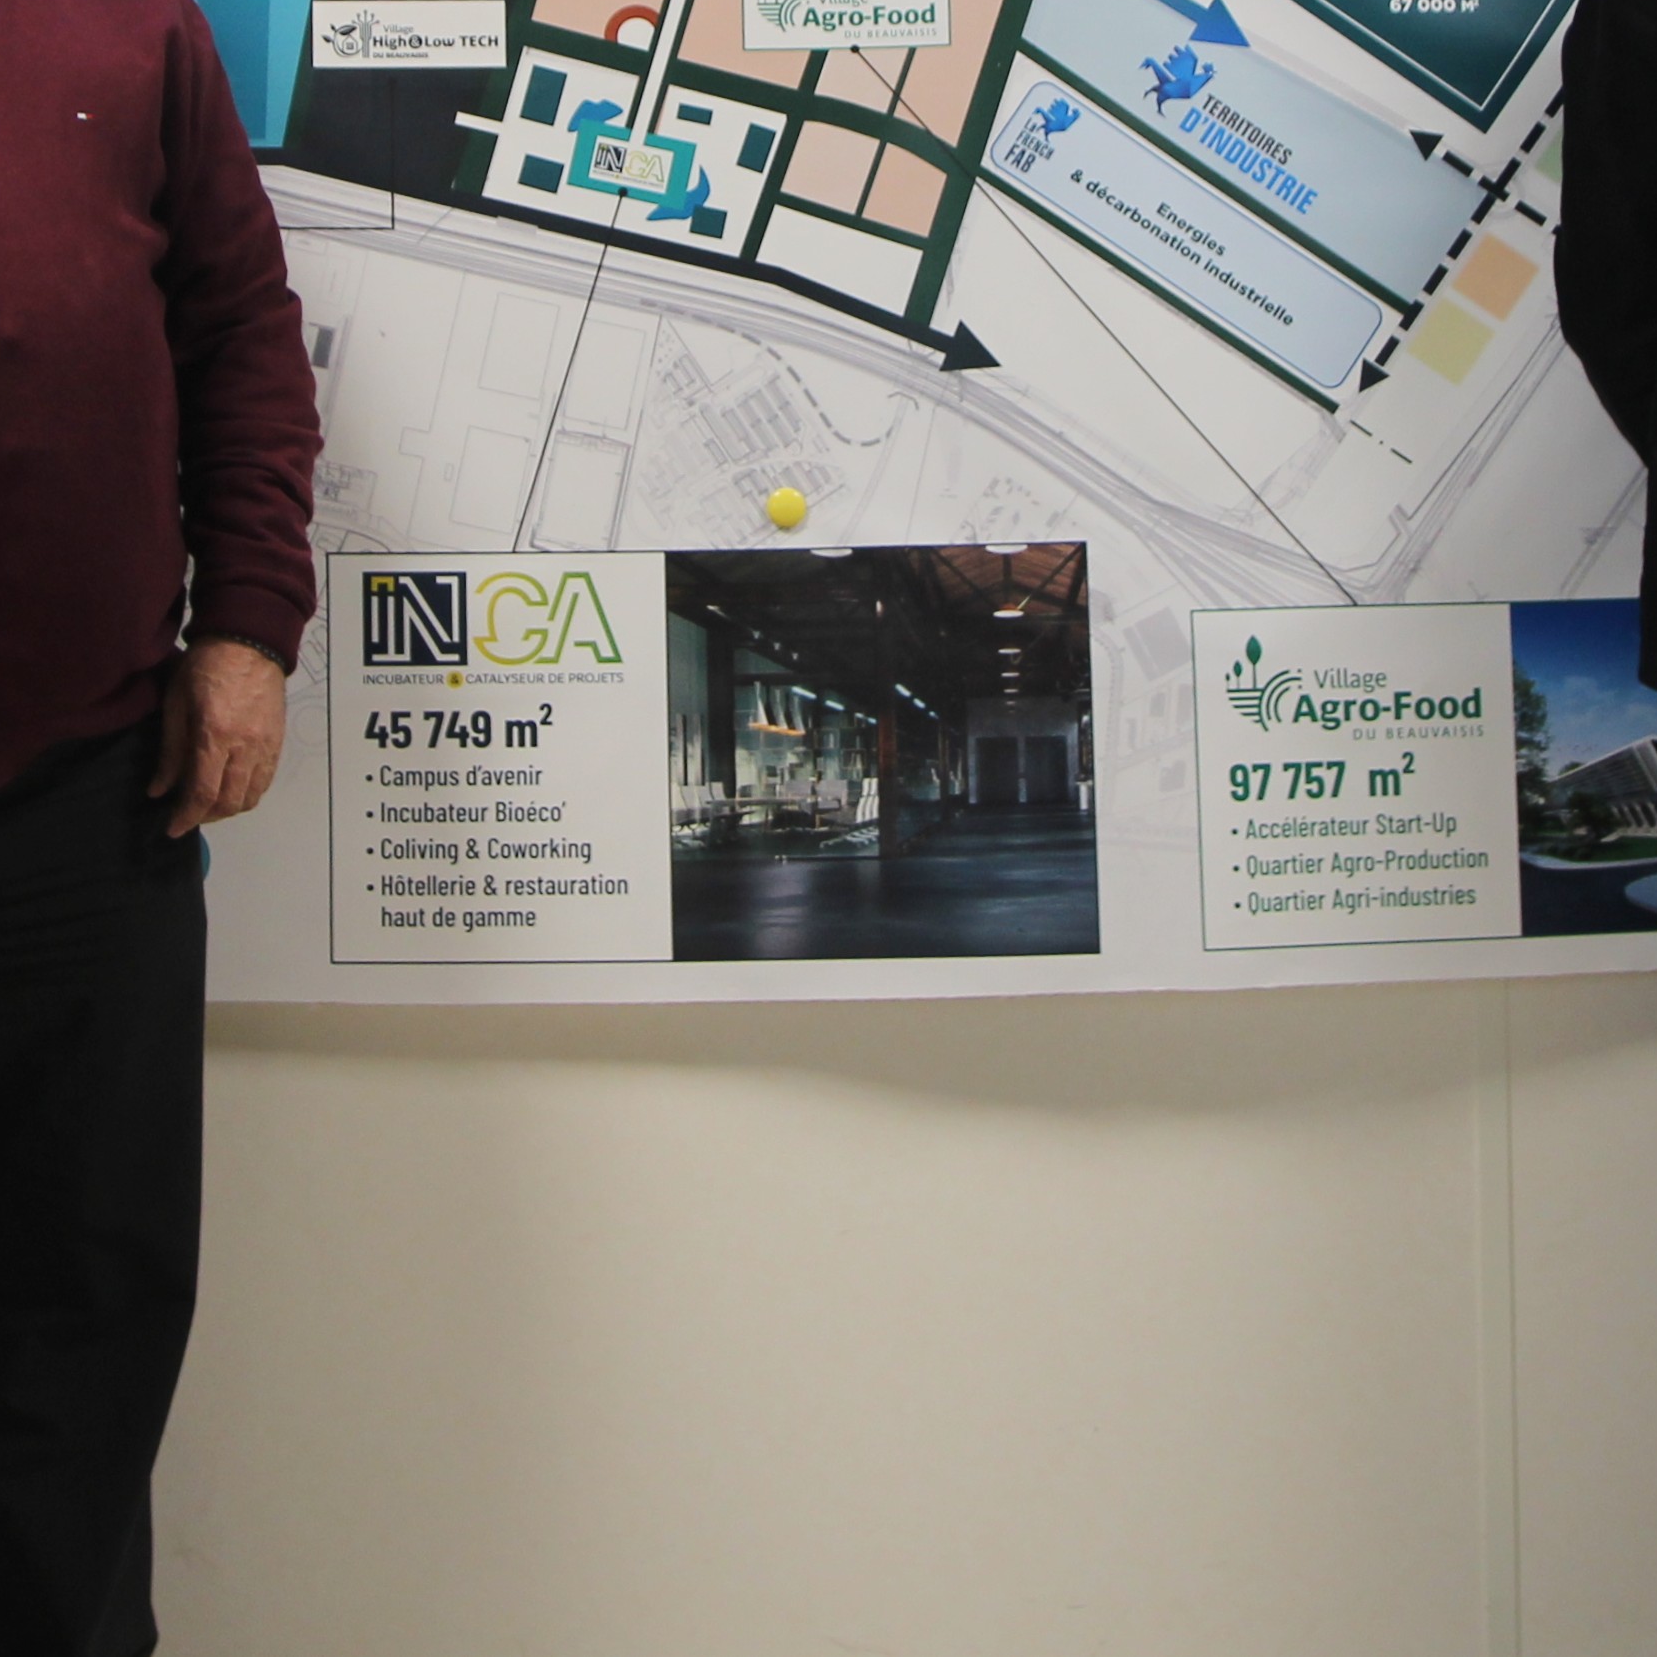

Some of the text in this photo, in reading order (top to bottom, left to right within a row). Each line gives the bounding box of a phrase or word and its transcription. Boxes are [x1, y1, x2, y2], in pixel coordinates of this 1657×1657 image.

[383, 24, 414, 36] Village
[802, 2, 937, 32] Agro-Food
[459, 35, 499, 48] TECH
[844, 27, 939, 40] DU BEAUVAISIS
[1024, 117, 1038, 133] La
[1201, 93, 1294, 166] TERRITOIRES
[1003, 145, 1037, 174] FAB
[1016, 130, 1056, 161] FRENCH
[1178, 107, 1319, 217] D'INDUSTRIE
[1155, 200, 1228, 257] Energies
[1070, 169, 1295, 328] & décarbonation industrielle
[362, 673, 444, 686] INCUBATEUR
[465, 672, 545, 685] CATALYSEUR
[548, 672, 565, 684] DE
[568, 671, 625, 684] PROJETS
[1314, 667, 1388, 693] Village
[1292, 688, 1483, 731] Agro-Food
[364, 710, 412, 749] 45
[423, 710, 492, 749] 749
[1352, 724, 1485, 741] DU BEAUVAISIS
[380, 764, 543, 791] Campus d'avenir
[1229, 763, 1272, 802] 97
[1283, 761, 1347, 799] 757
[380, 802, 488, 823] Incubateur
[1245, 812, 1457, 840] Accélérateur Start-Up
[381, 838, 592, 865] Coliving & Coworking
[1246, 848, 1489, 878] Quartier Agro-Production
[381, 873, 629, 896] Hôtellerie & restauration
[1248, 884, 1477, 915] Quartier Agri-industries
[381, 907, 537, 933] haut de gamme
